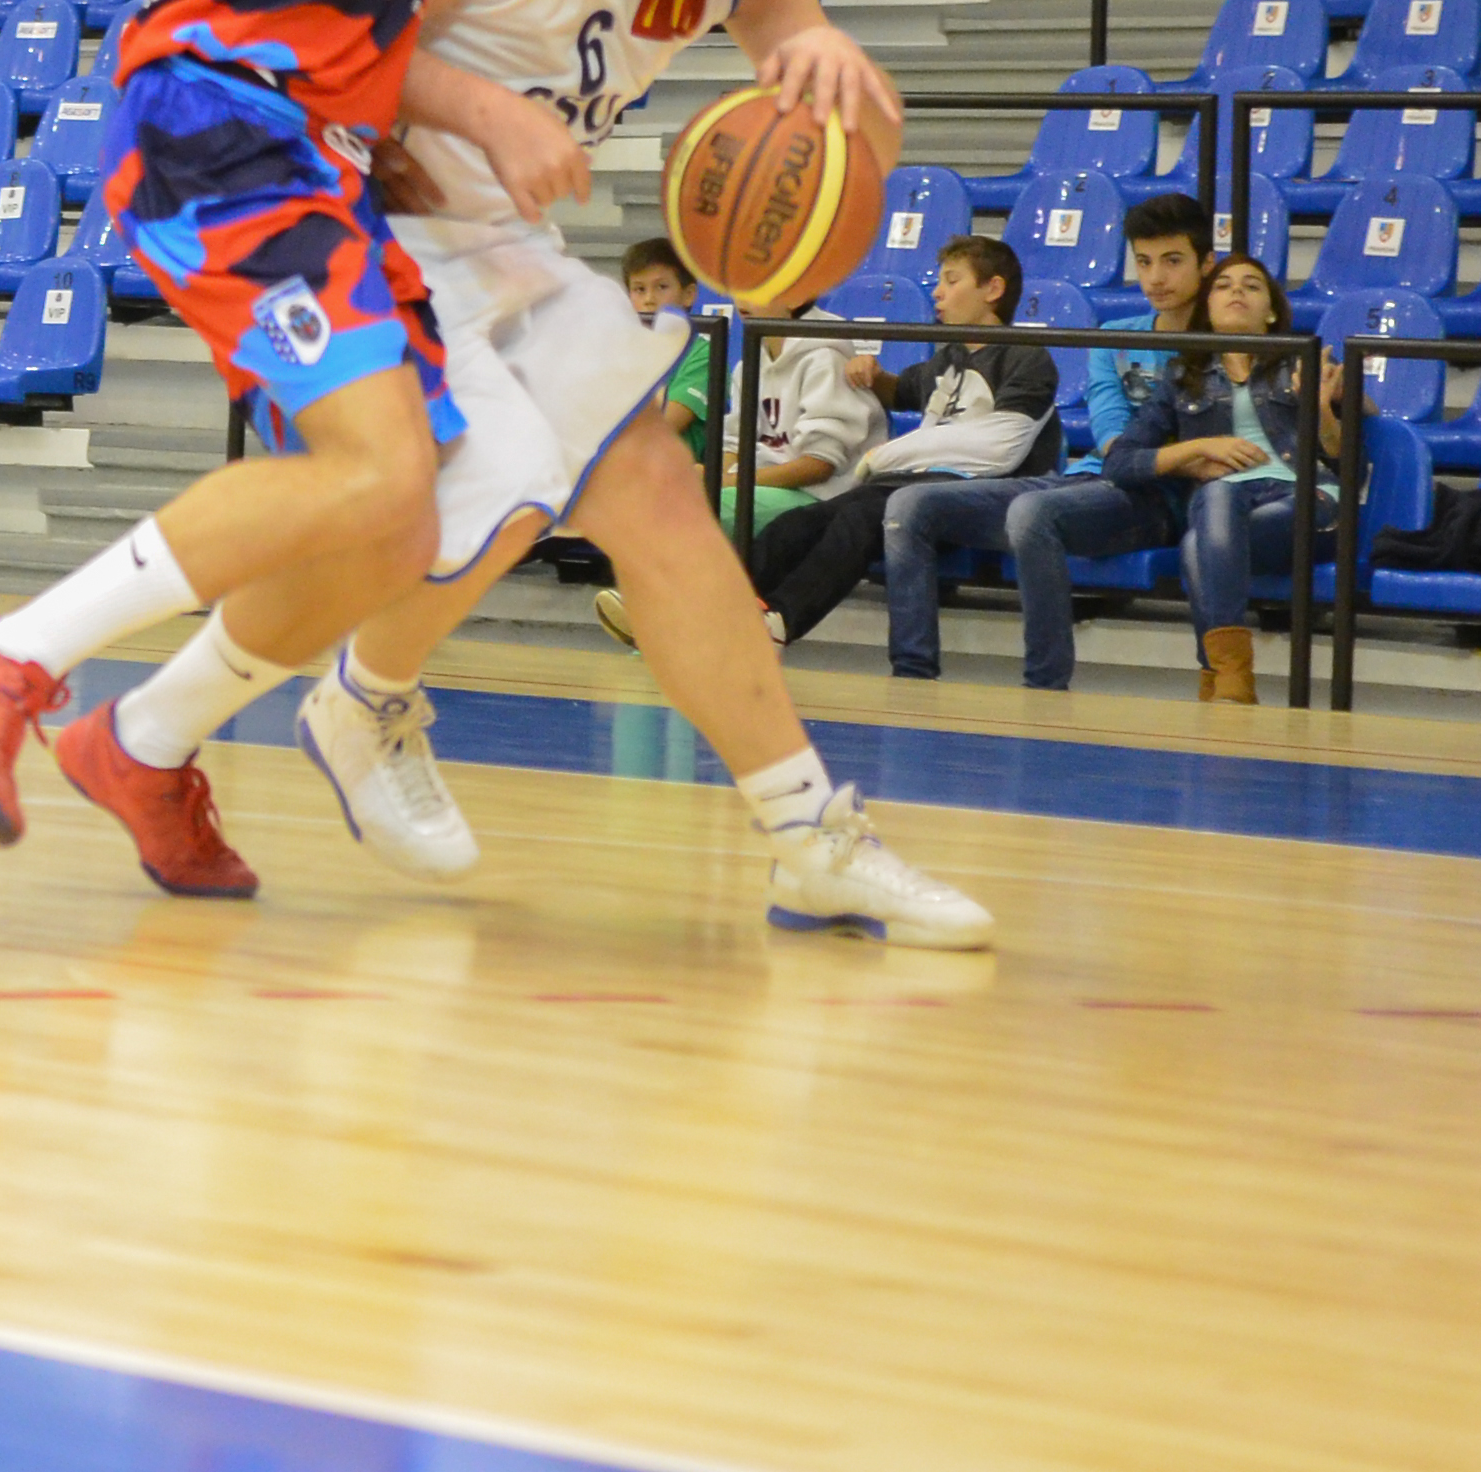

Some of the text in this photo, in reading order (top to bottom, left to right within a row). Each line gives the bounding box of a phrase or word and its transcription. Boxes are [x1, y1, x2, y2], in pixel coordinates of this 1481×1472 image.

[577, 10, 612, 95] 6
[523, 87, 622, 133] SU
[743, 132, 815, 265] molten
[53, 271, 74, 289] 10
[47, 307, 66, 319] VIP
